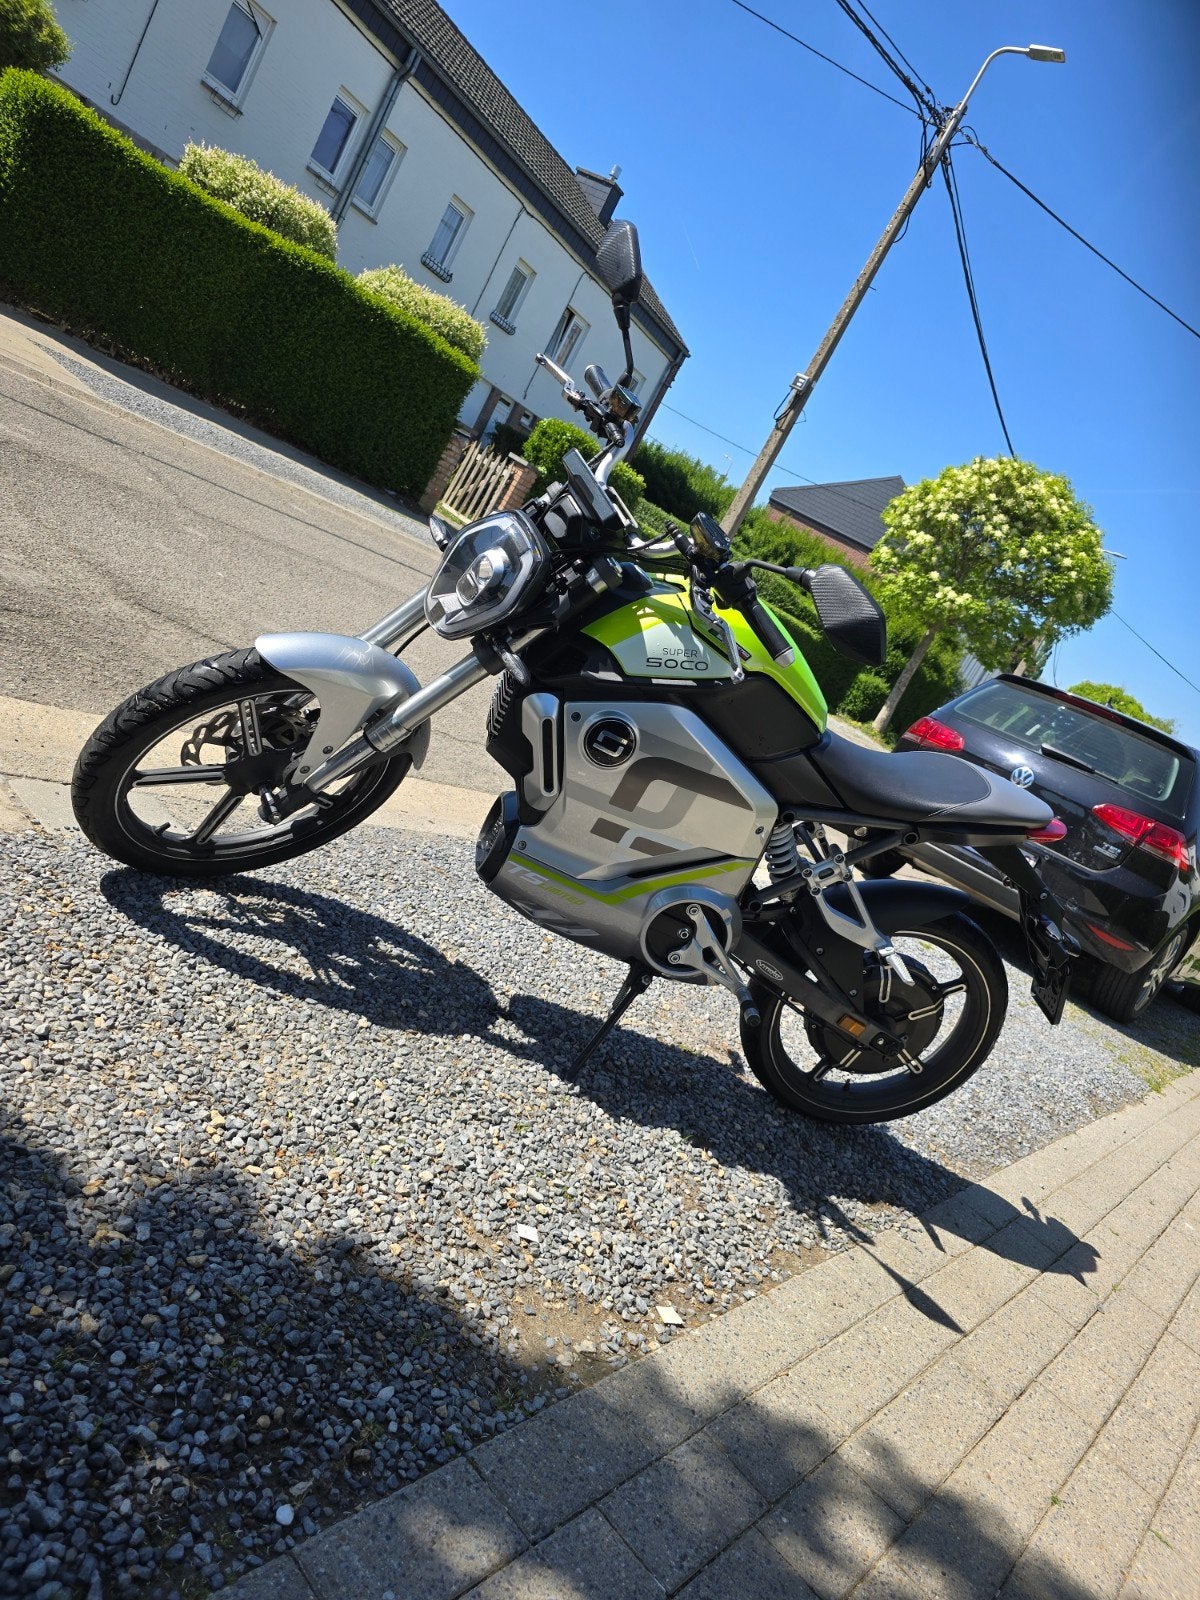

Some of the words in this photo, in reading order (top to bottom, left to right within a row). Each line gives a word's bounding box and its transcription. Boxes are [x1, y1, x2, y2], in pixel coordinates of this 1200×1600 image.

[662, 647, 698, 658] SUPER
[646, 657, 709, 671] SOCO
[507, 860, 549, 885] TS
